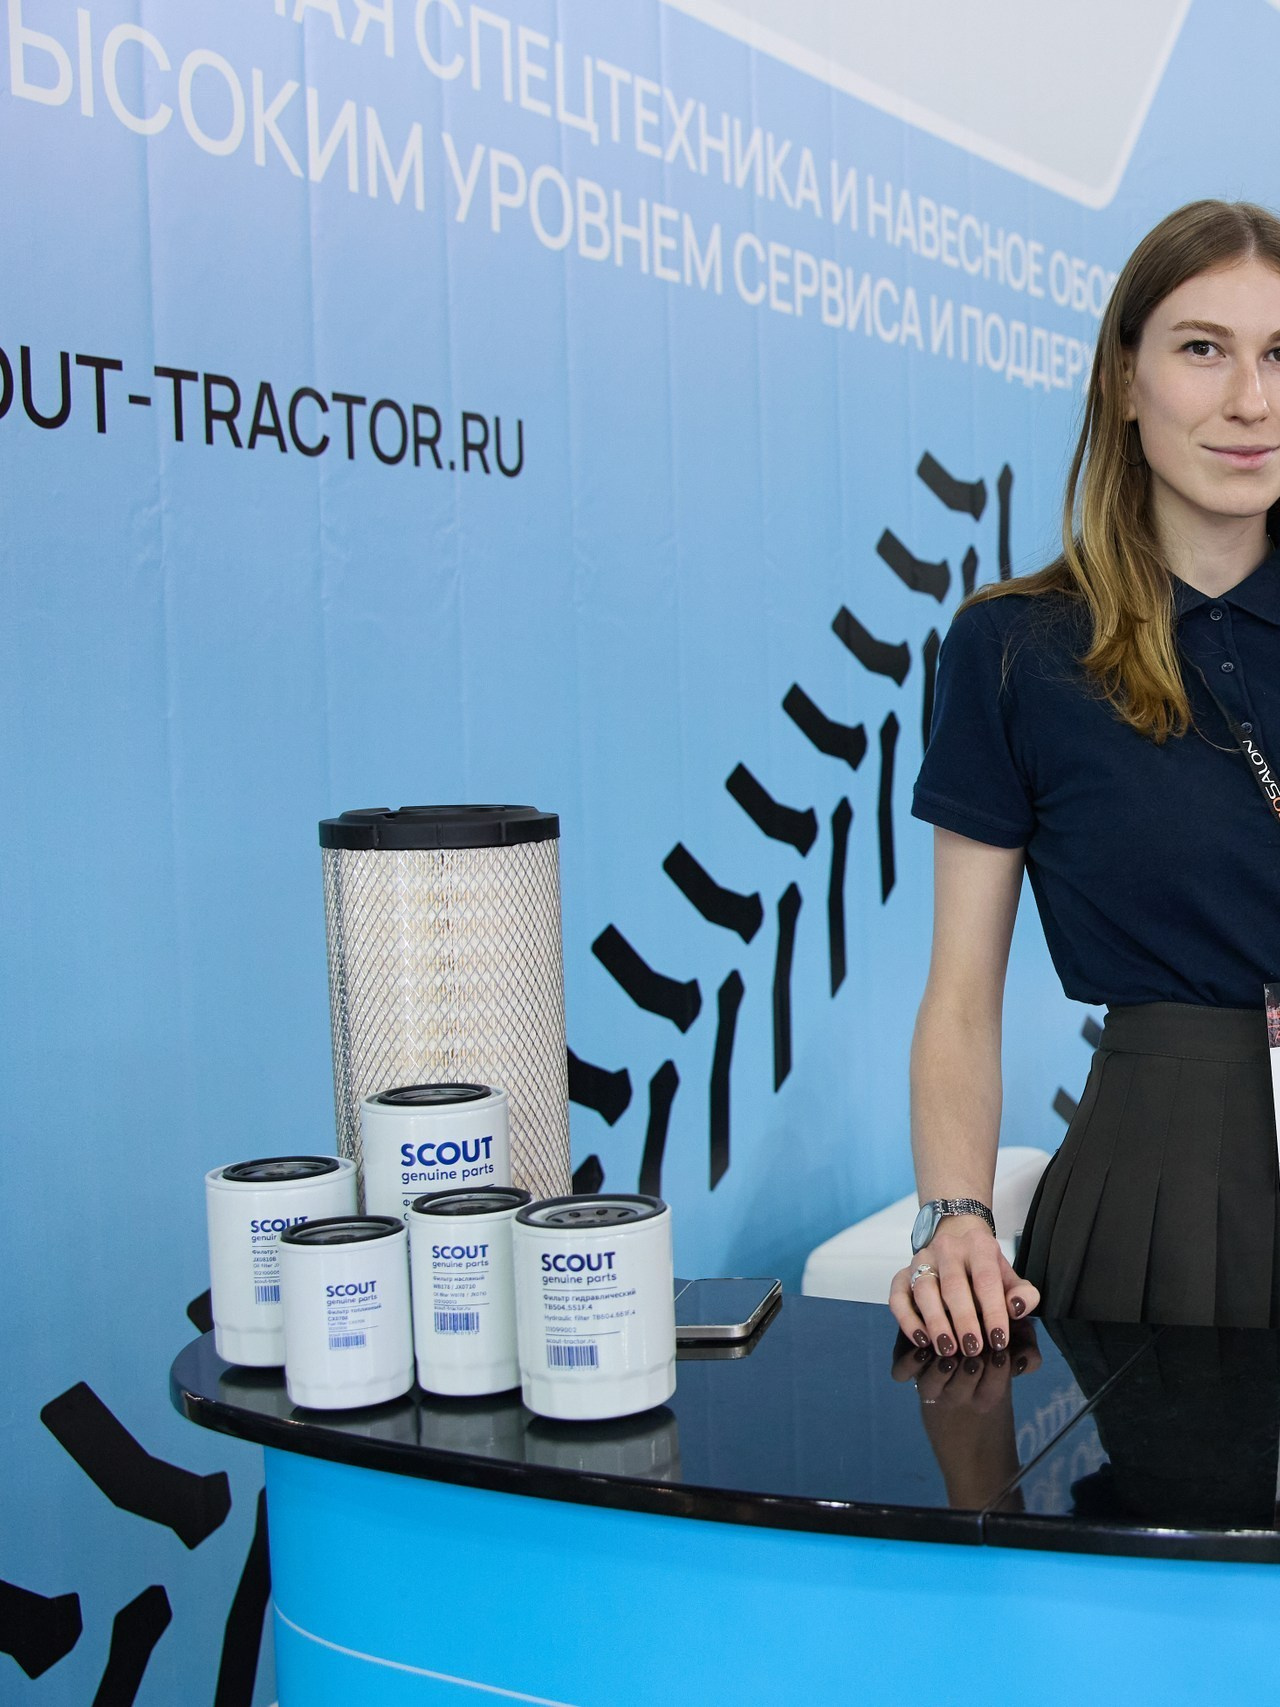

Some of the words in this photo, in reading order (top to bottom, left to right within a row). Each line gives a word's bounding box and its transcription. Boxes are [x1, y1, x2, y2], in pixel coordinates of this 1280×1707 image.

[414, 0, 823, 218] СПЕЦТЕХНИКА
[831, 158, 858, 231] И
[866, 175, 1045, 298] НАВЕСНОЕ
[1050, 249, 1118, 320] ОБО
[441, 132, 722, 296] УРОВНЕМ
[733, 232, 924, 355] СЕРВИСА
[930, 294, 955, 361] И
[0, 345, 525, 478] UT-TRACTOR.RU
[400, 1136, 493, 1167] SCOUT
[402, 1169, 457, 1184] genuine
[462, 1163, 494, 1181] parts
[432, 1244, 489, 1260] SCOUT
[541, 1251, 616, 1272] SCOUT
[432, 1261, 463, 1269] genuine
[466, 1260, 489, 1269] parts
[326, 1280, 377, 1297] SCOUT
[542, 1274, 583, 1286] genuine
[587, 1273, 617, 1286] parts
[326, 1297, 356, 1306] genuine
[358, 1294, 378, 1303] parts
[543, 1294, 570, 1303] Фильтр
[572, 1288, 637, 1303] гидравлический
